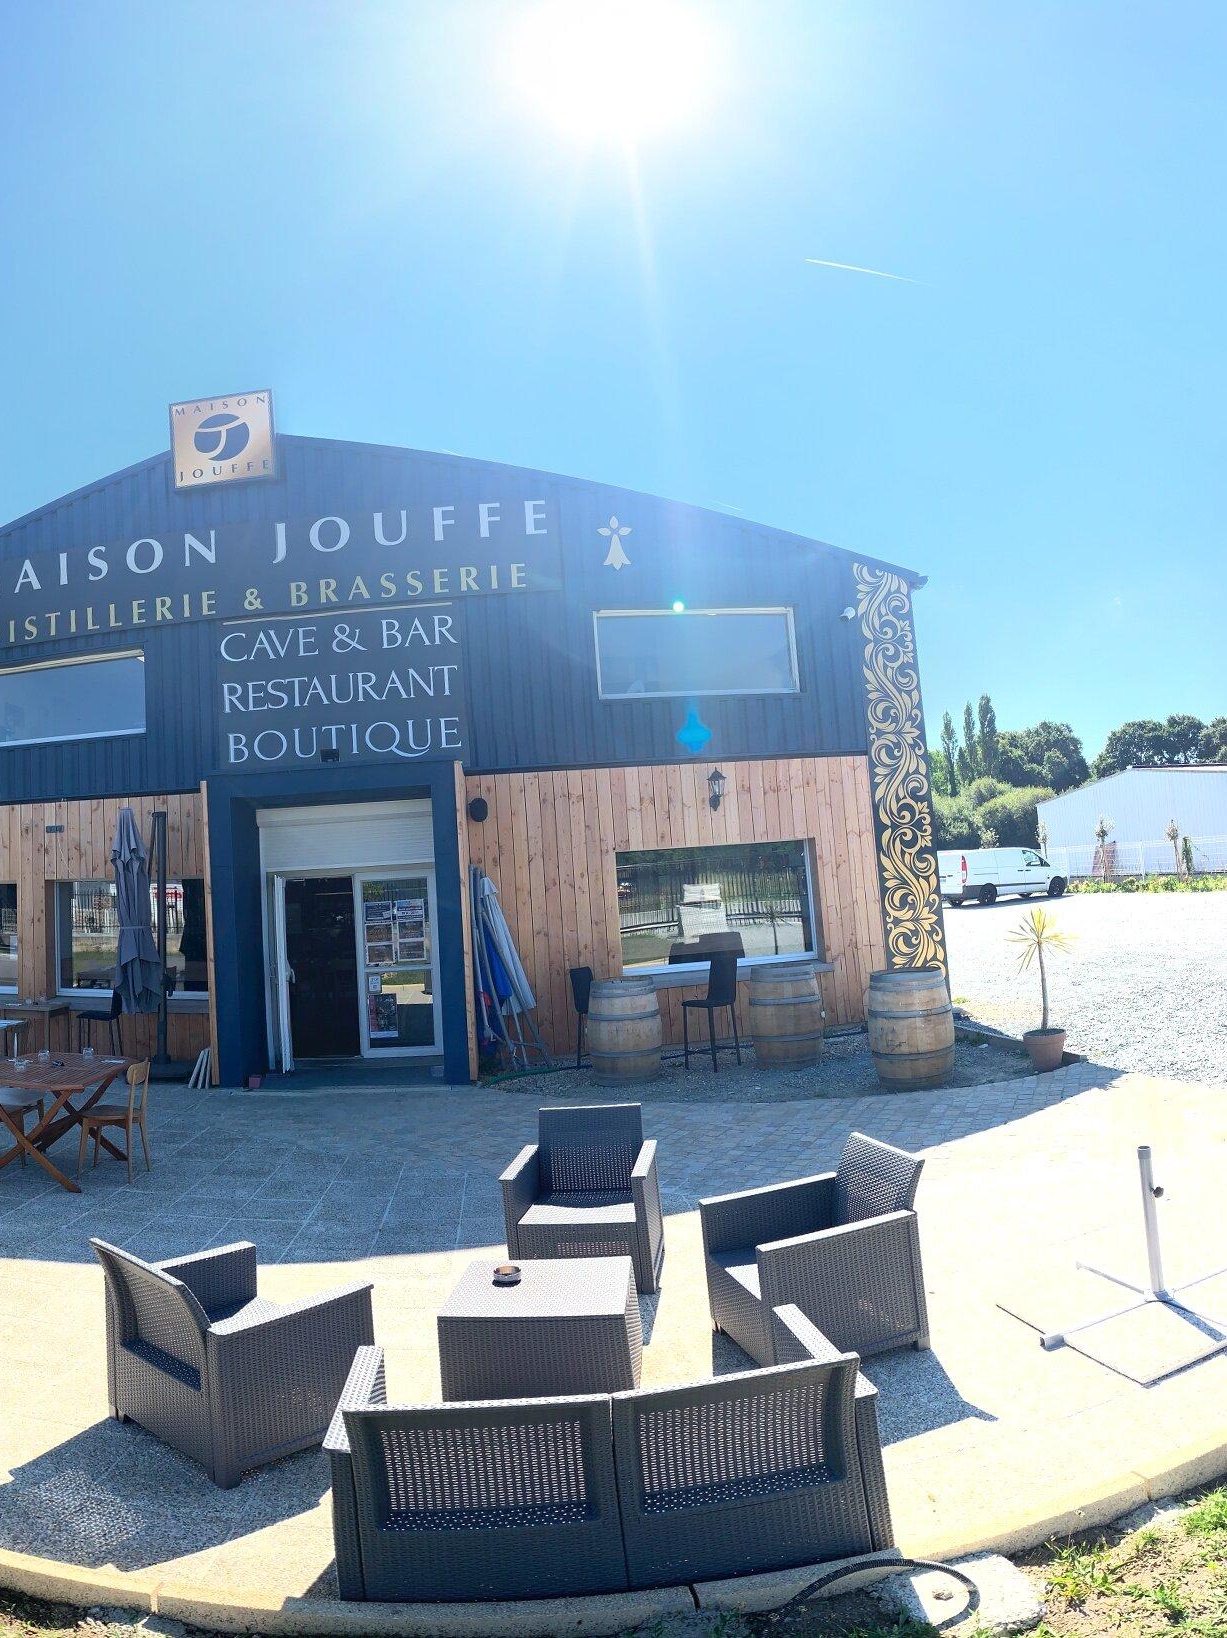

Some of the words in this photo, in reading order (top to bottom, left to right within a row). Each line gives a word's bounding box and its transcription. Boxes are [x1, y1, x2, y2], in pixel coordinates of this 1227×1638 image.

[175, 395, 266, 417] MAISON
[179, 459, 269, 482] JOUFFE
[272, 500, 548, 564] JOUFFE
[243, 588, 264, 611] &
[289, 563, 527, 607] BRASSERIE
[220, 626, 319, 662] CAVE
[332, 623, 368, 653] &
[381, 615, 458, 649] BAR
[222, 665, 458, 714] RESTAURANT
[227, 716, 462, 764] BOUTIQUE
